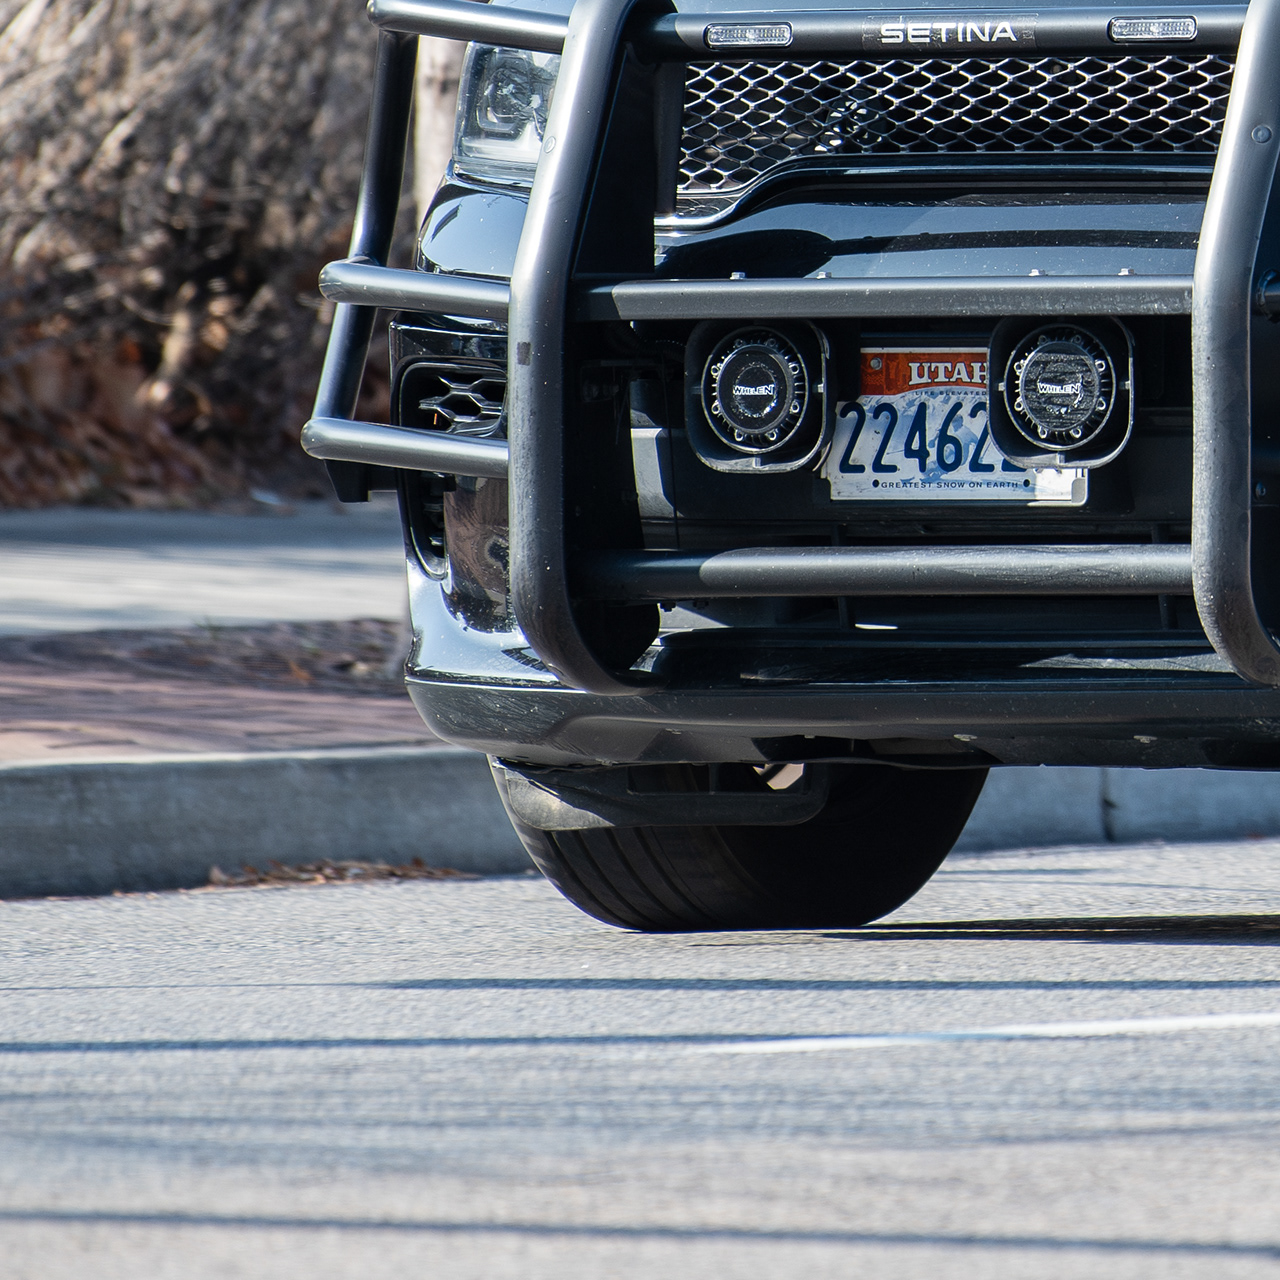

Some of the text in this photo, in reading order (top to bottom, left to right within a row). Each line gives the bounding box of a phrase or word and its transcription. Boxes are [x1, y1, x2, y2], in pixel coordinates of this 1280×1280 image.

[881, 22, 1017, 43] SETINA
[908, 362, 988, 385] UTAH
[1038, 382, 1082, 393] WHELEN
[839, 401, 1028, 473] 22462
[881, 481, 932, 489] GREATEST
[936, 481, 965, 489] SNOW
